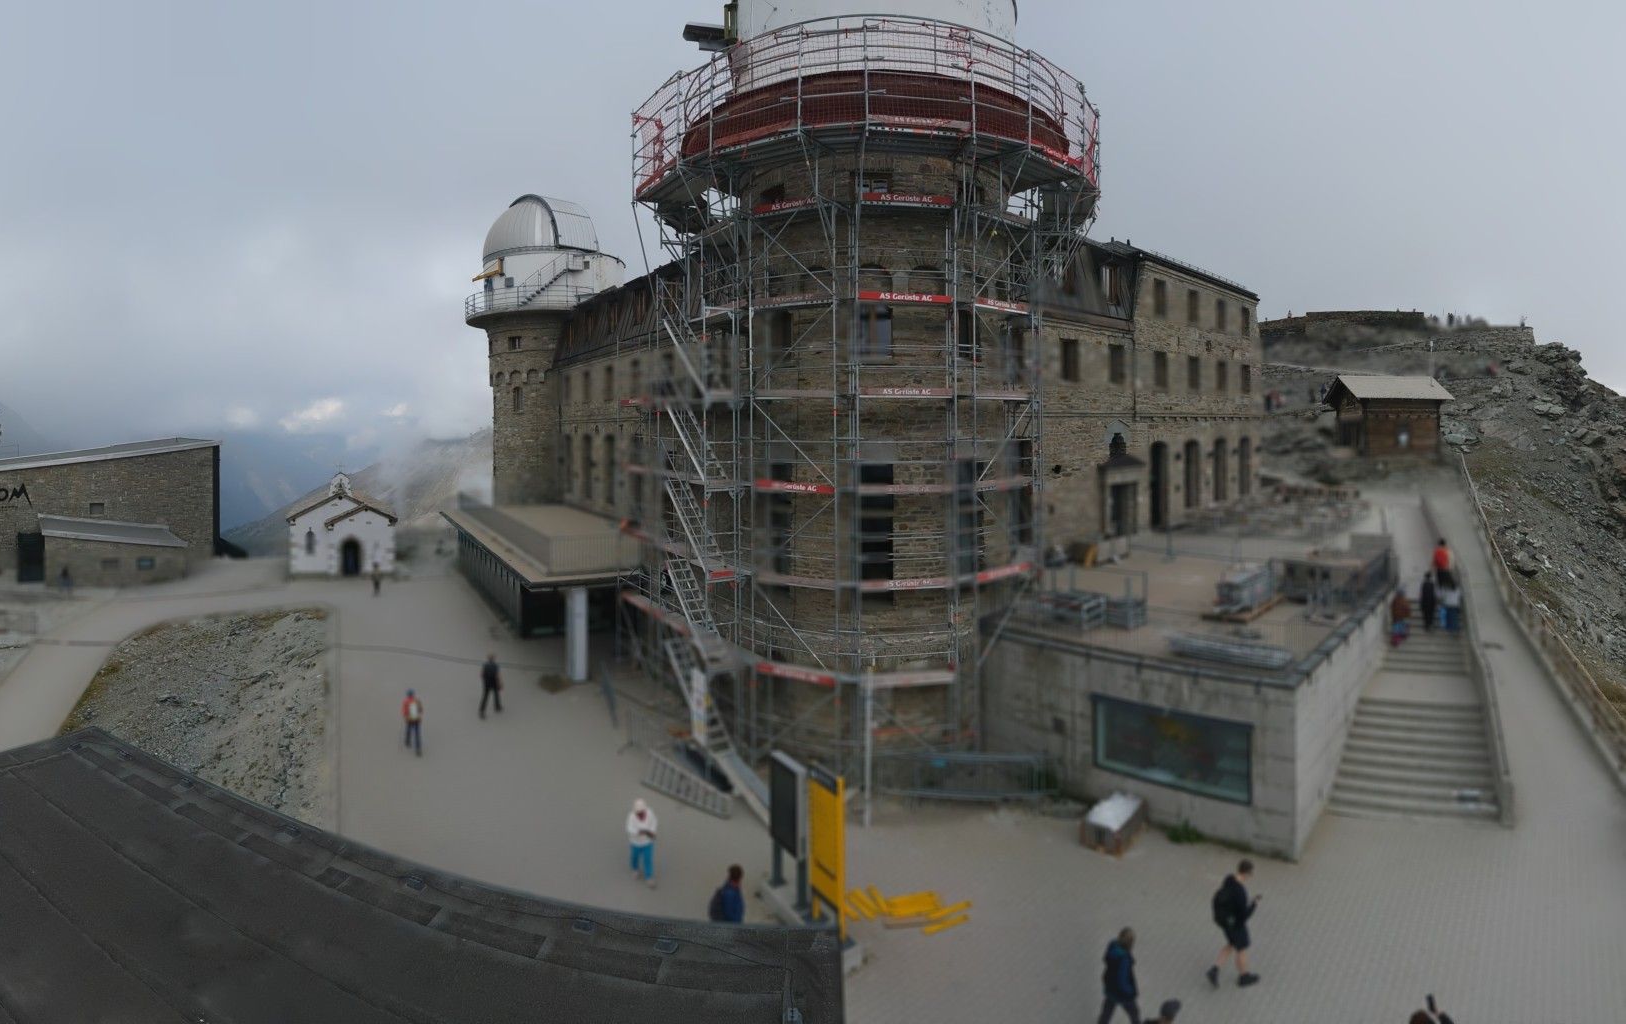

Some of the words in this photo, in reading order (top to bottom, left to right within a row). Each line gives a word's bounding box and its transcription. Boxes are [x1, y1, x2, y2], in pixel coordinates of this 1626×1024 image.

[893, 194, 920, 202] Gerüste
[879, 292, 891, 300] AS
[892, 293, 920, 301] Gerüste
[921, 294, 933, 302] AG
